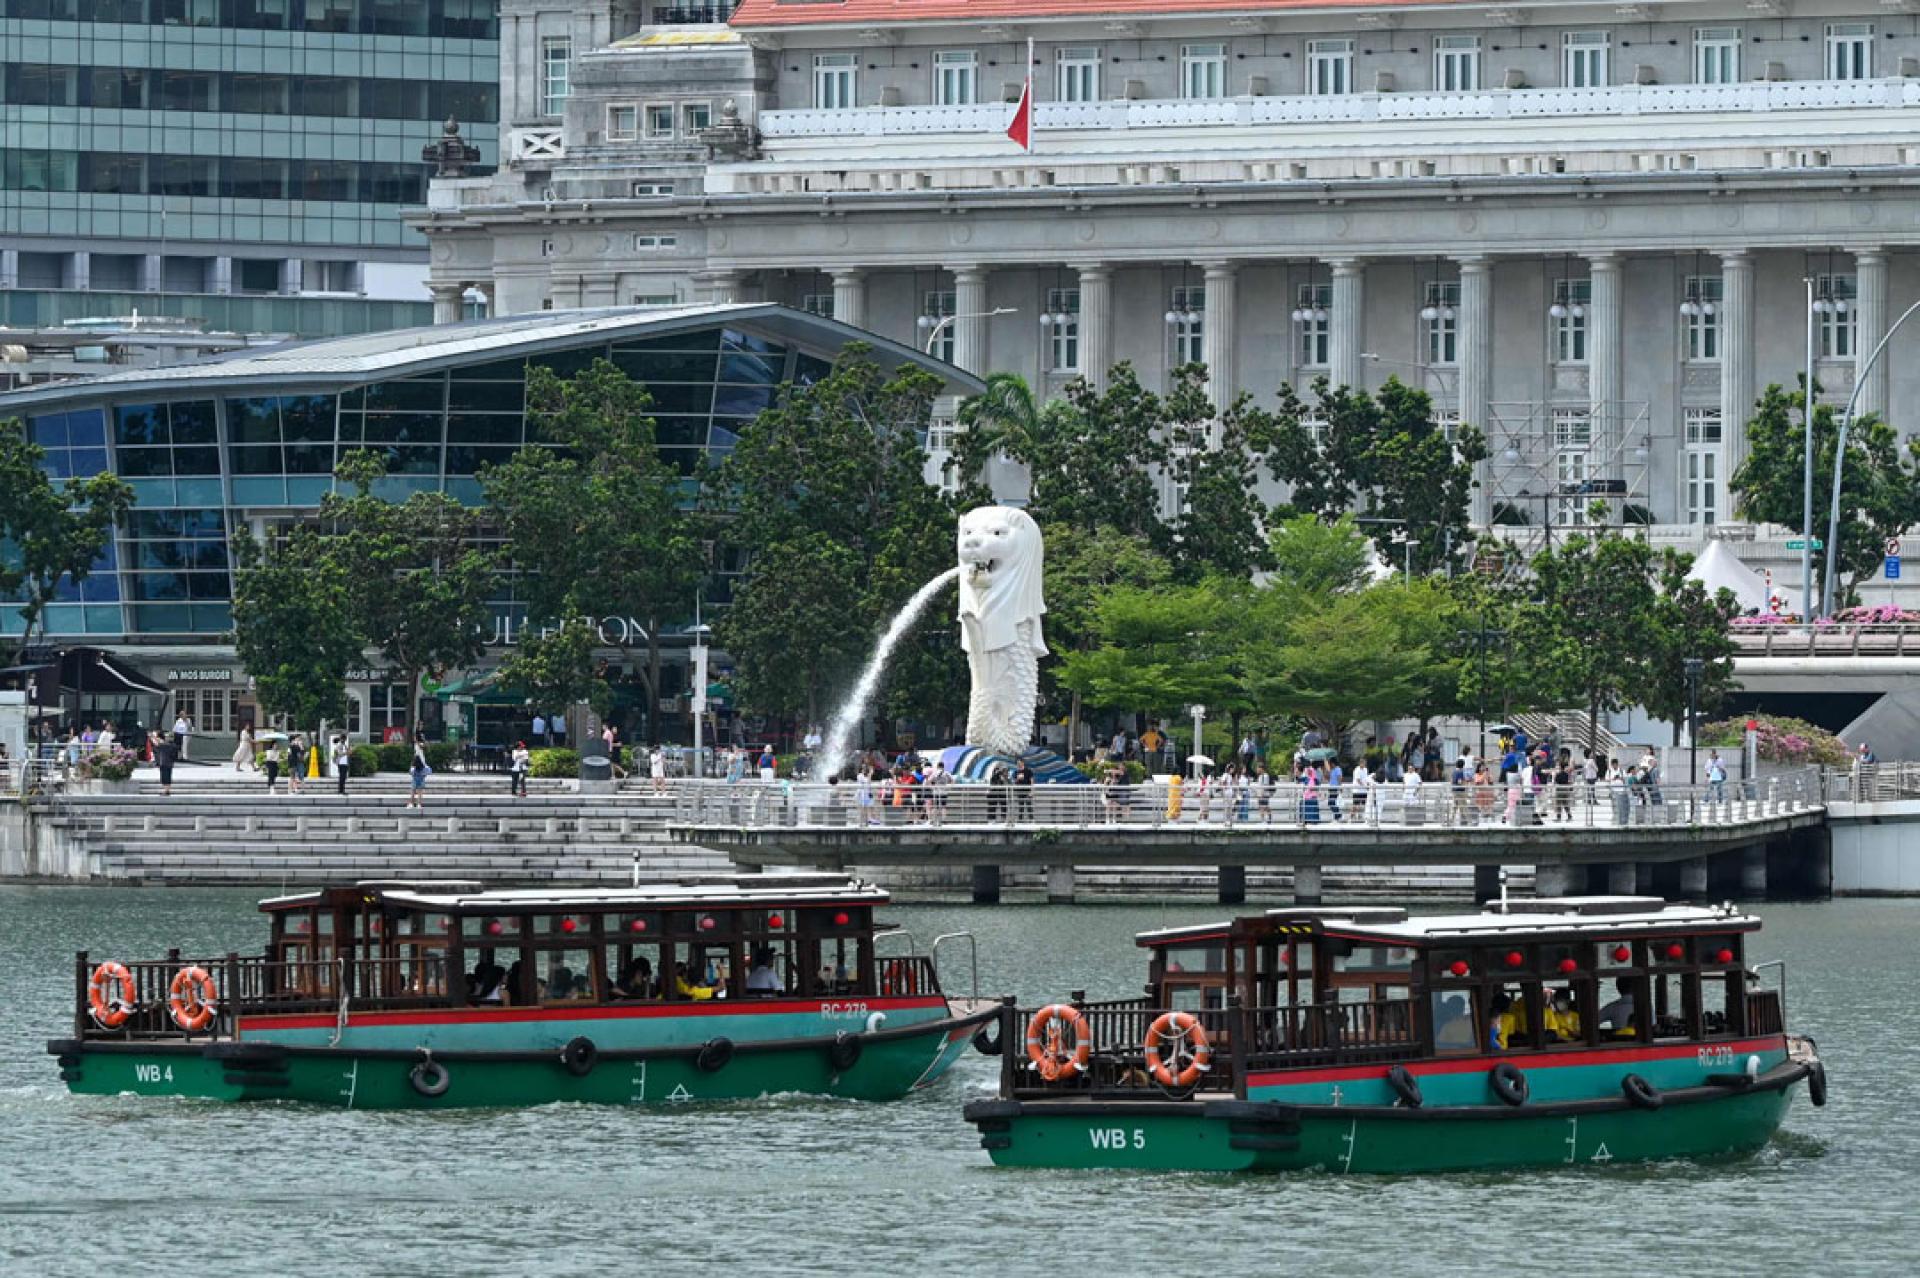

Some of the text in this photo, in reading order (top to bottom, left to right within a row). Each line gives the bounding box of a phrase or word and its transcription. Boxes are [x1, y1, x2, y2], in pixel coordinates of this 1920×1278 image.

[180, 670, 198, 679] MOS
[200, 670, 231, 680] BURGER
[821, 1002, 867, 1019] RC 278
[1698, 1047, 1713, 1067] RC
[135, 1064, 173, 1082] WB 4
[1089, 1128, 1146, 1149] WB 5
